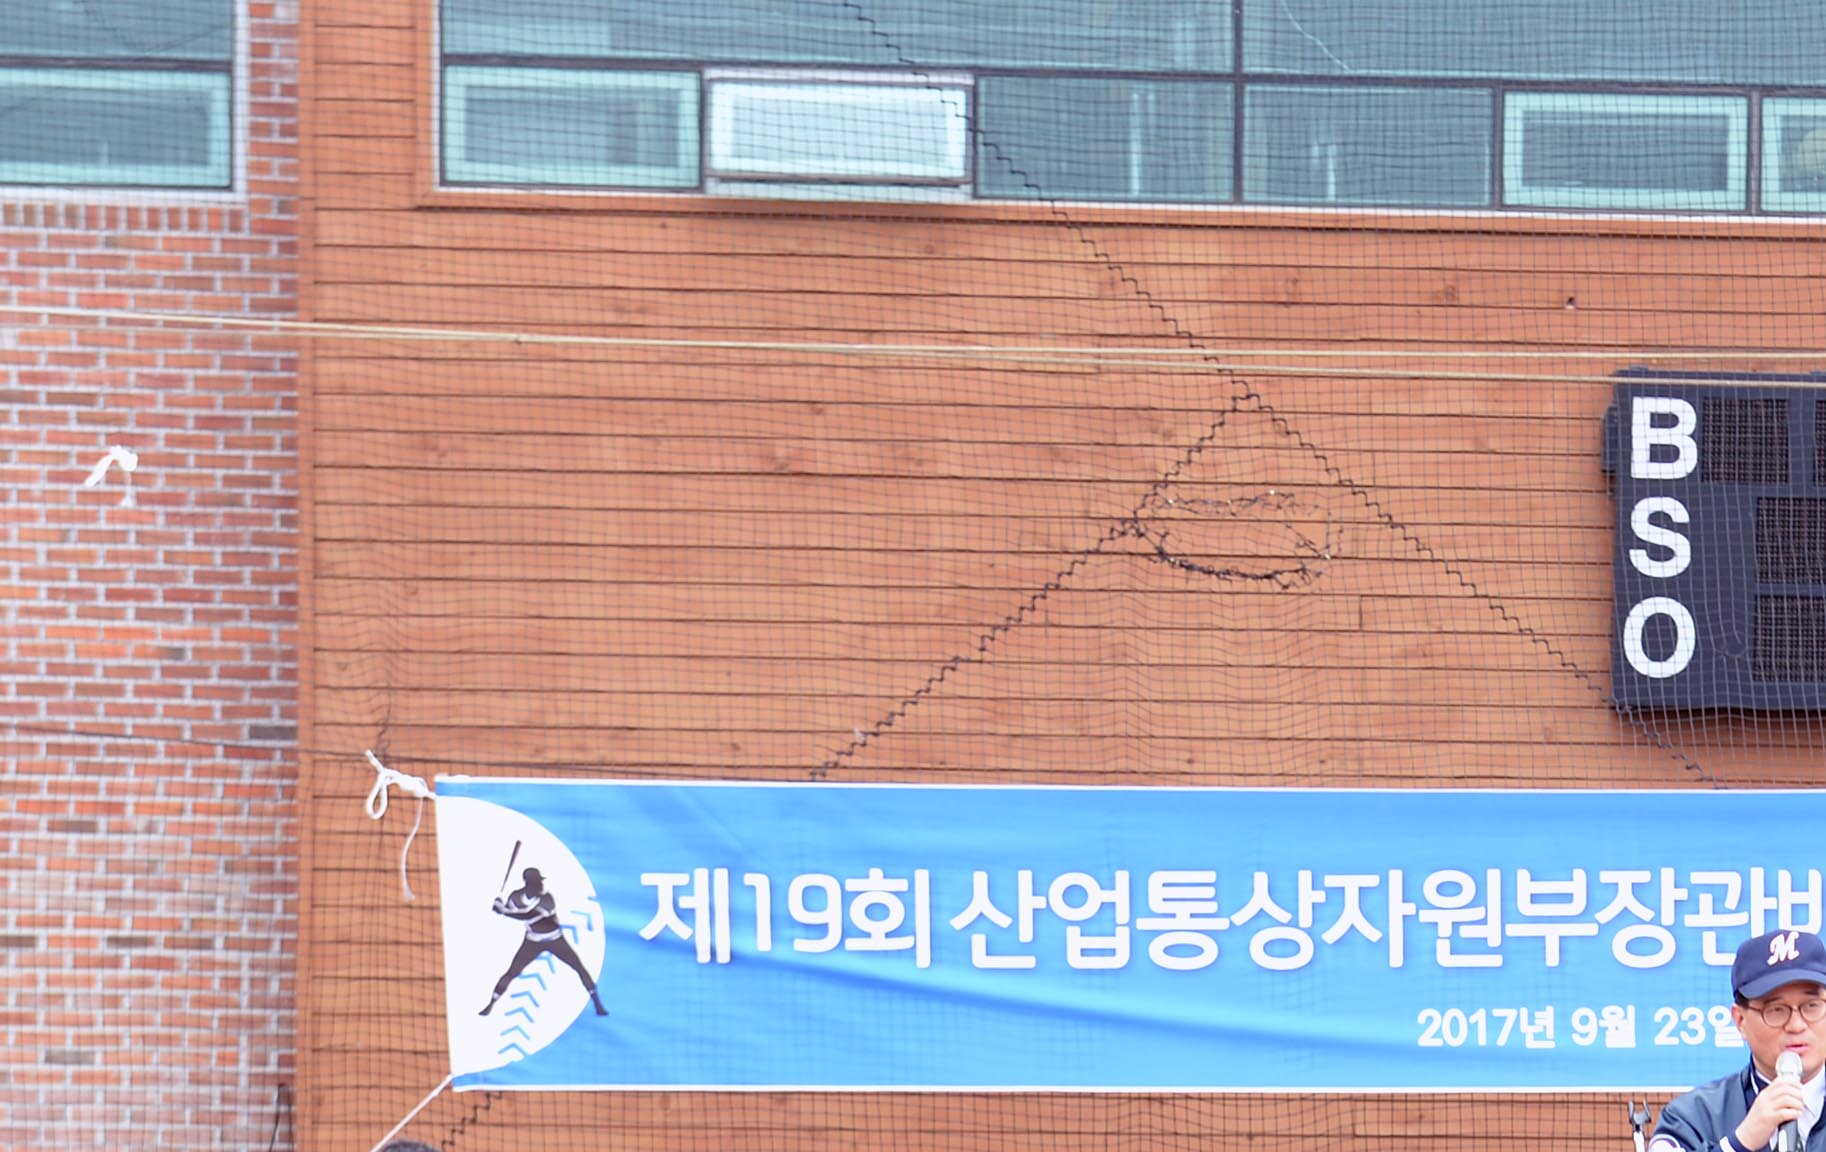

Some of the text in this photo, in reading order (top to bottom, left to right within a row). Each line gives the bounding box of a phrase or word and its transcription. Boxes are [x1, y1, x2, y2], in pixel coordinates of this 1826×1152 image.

[1631, 396, 1698, 480] B
[1628, 496, 1692, 579] S
[1623, 596, 1696, 679] O
[639, 867, 932, 969] 제19회
[1416, 1004, 1557, 1049] 2017년
[1570, 1004, 1637, 1049] 9월
